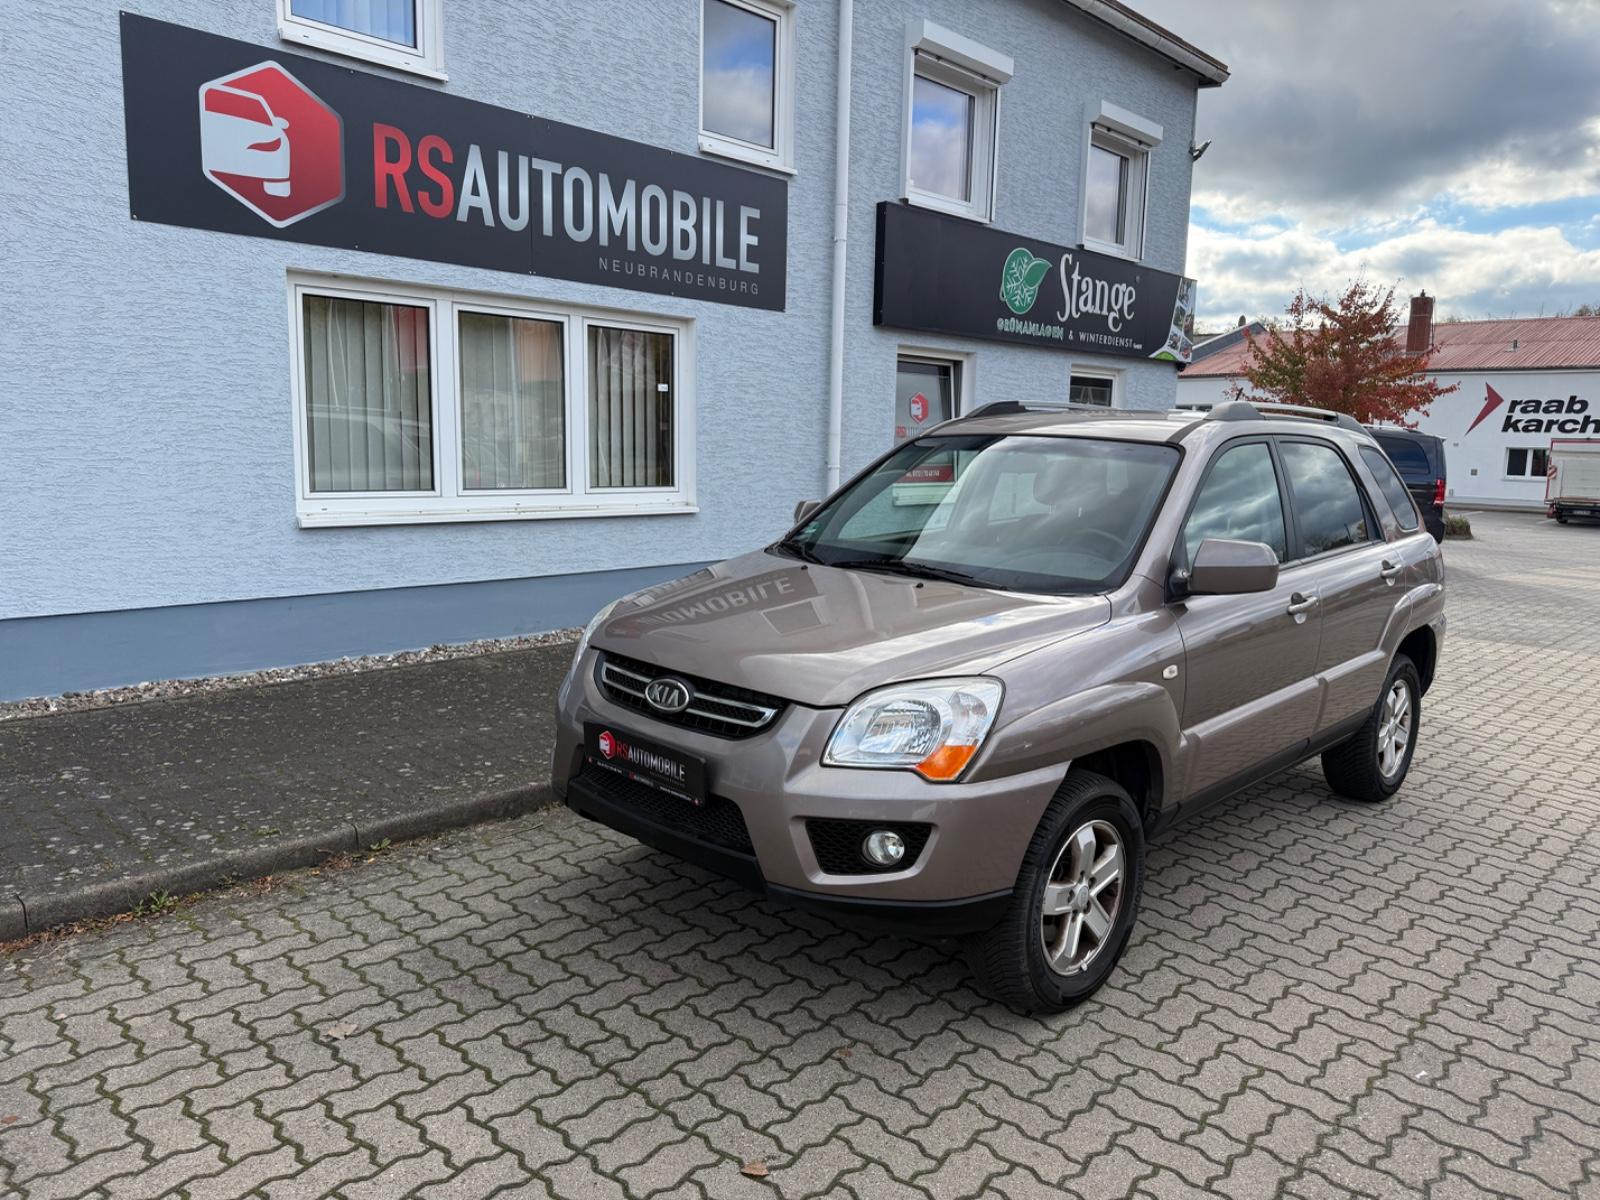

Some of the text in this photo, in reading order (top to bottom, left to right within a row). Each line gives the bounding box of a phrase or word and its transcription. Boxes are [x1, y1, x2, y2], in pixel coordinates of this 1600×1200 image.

[599, 257, 760, 295] NEUBRANDENBURG
[1056, 253, 1136, 332] Stange
[1068, 330, 1074, 340] &
[1079, 331, 1133, 348] WINTERDIENST
[1507, 395, 1589, 414] raab
[1501, 415, 1600, 433] karch
[651, 683, 679, 706] KIA
